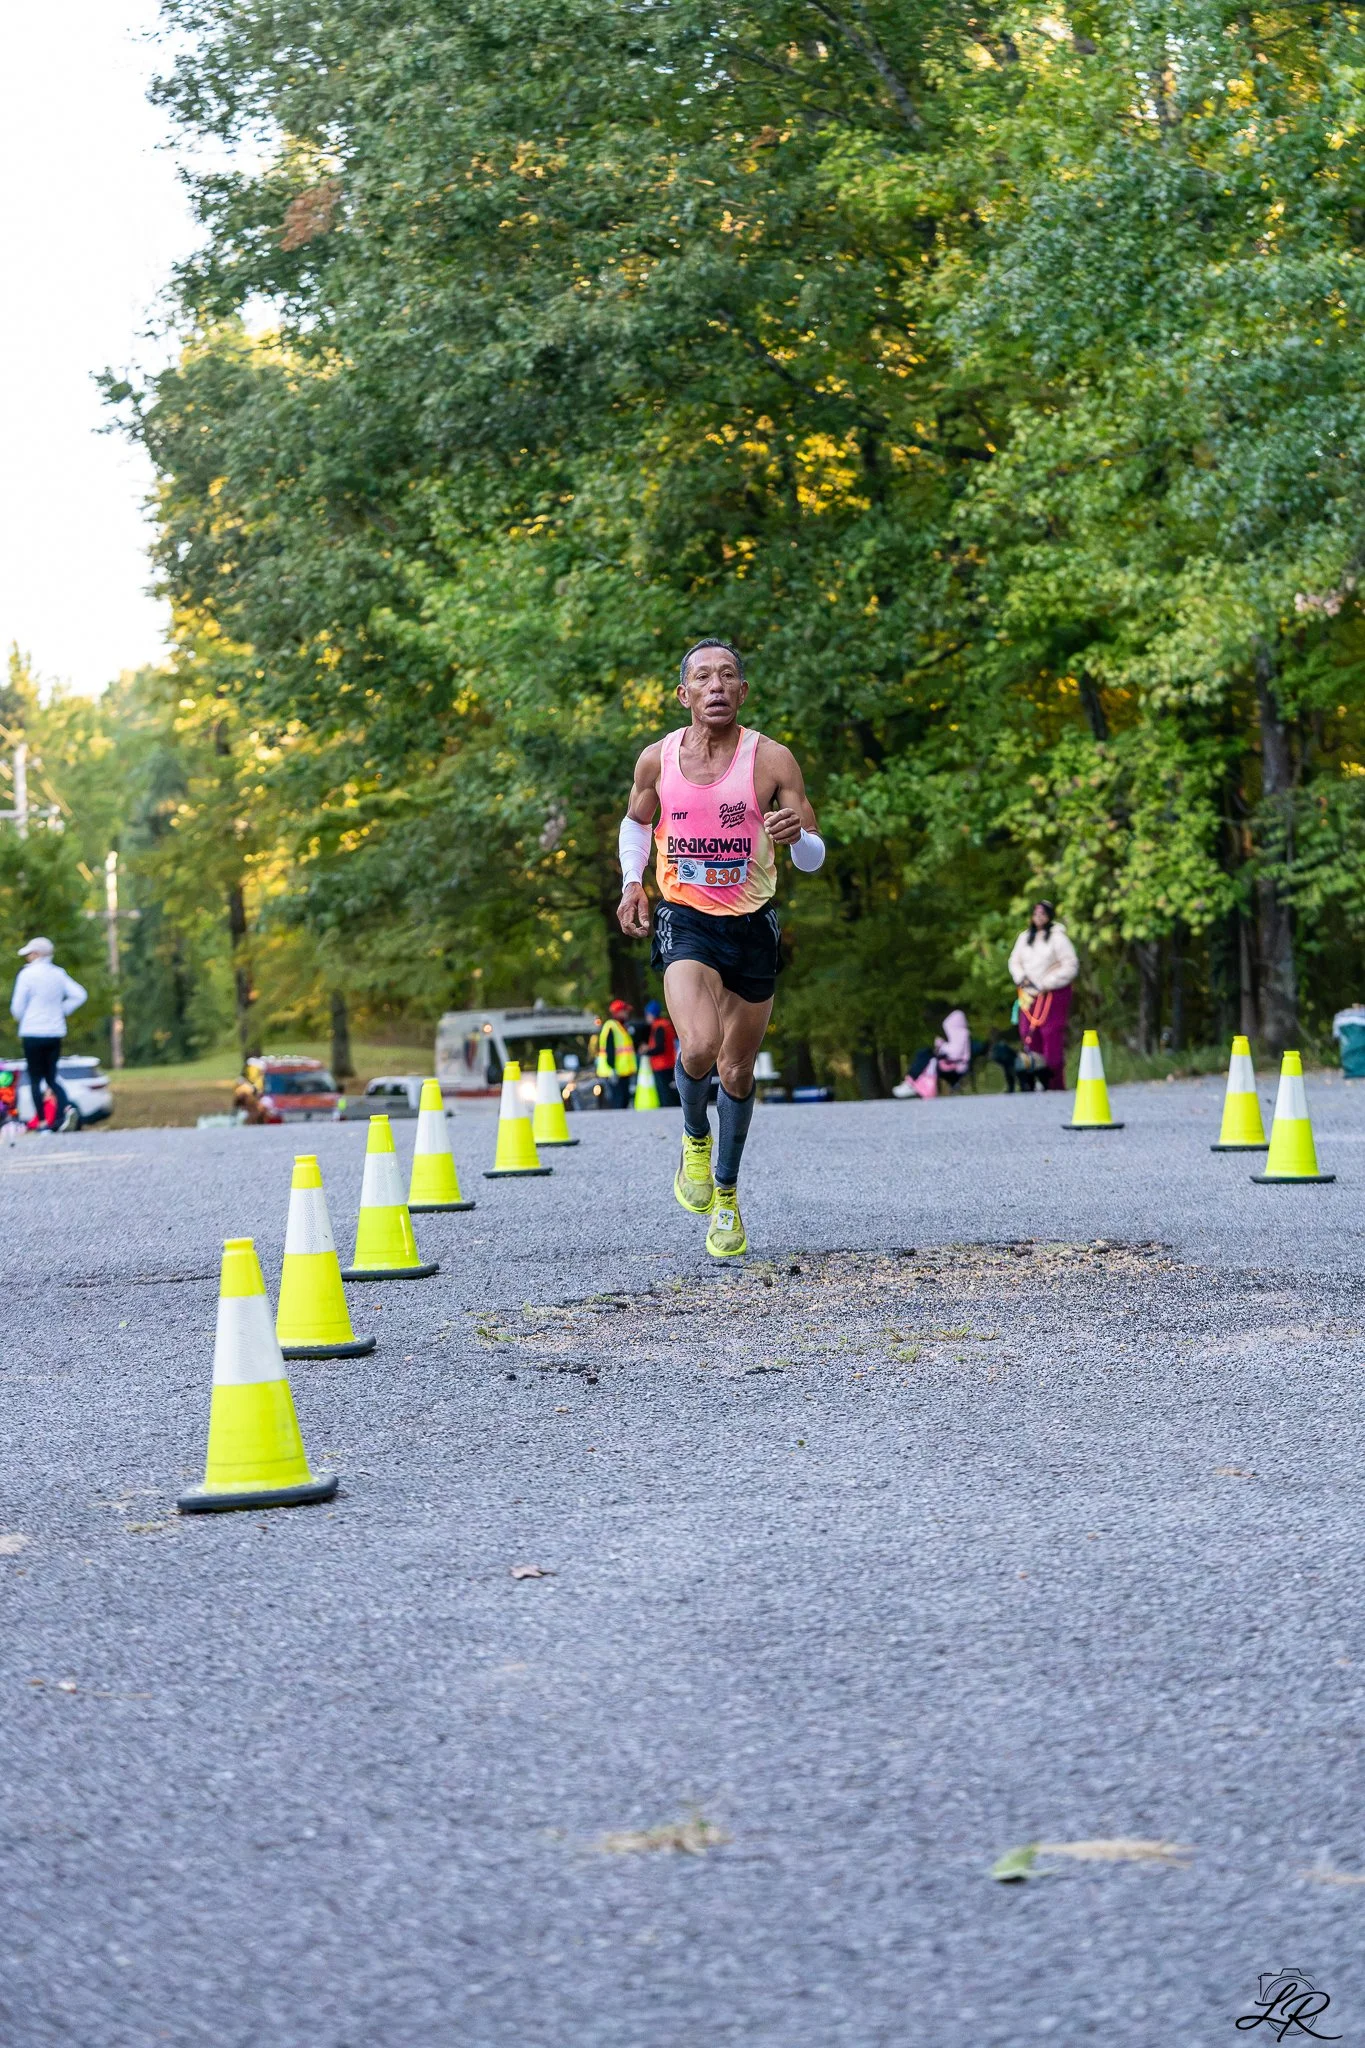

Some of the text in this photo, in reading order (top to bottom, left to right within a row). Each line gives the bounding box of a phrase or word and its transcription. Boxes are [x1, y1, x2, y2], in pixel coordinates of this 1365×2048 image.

[719, 801, 747, 818] Party
[721, 814, 745, 828] Pace
[667, 836, 752, 856] Breakaway
[705, 868, 741, 885] 830
